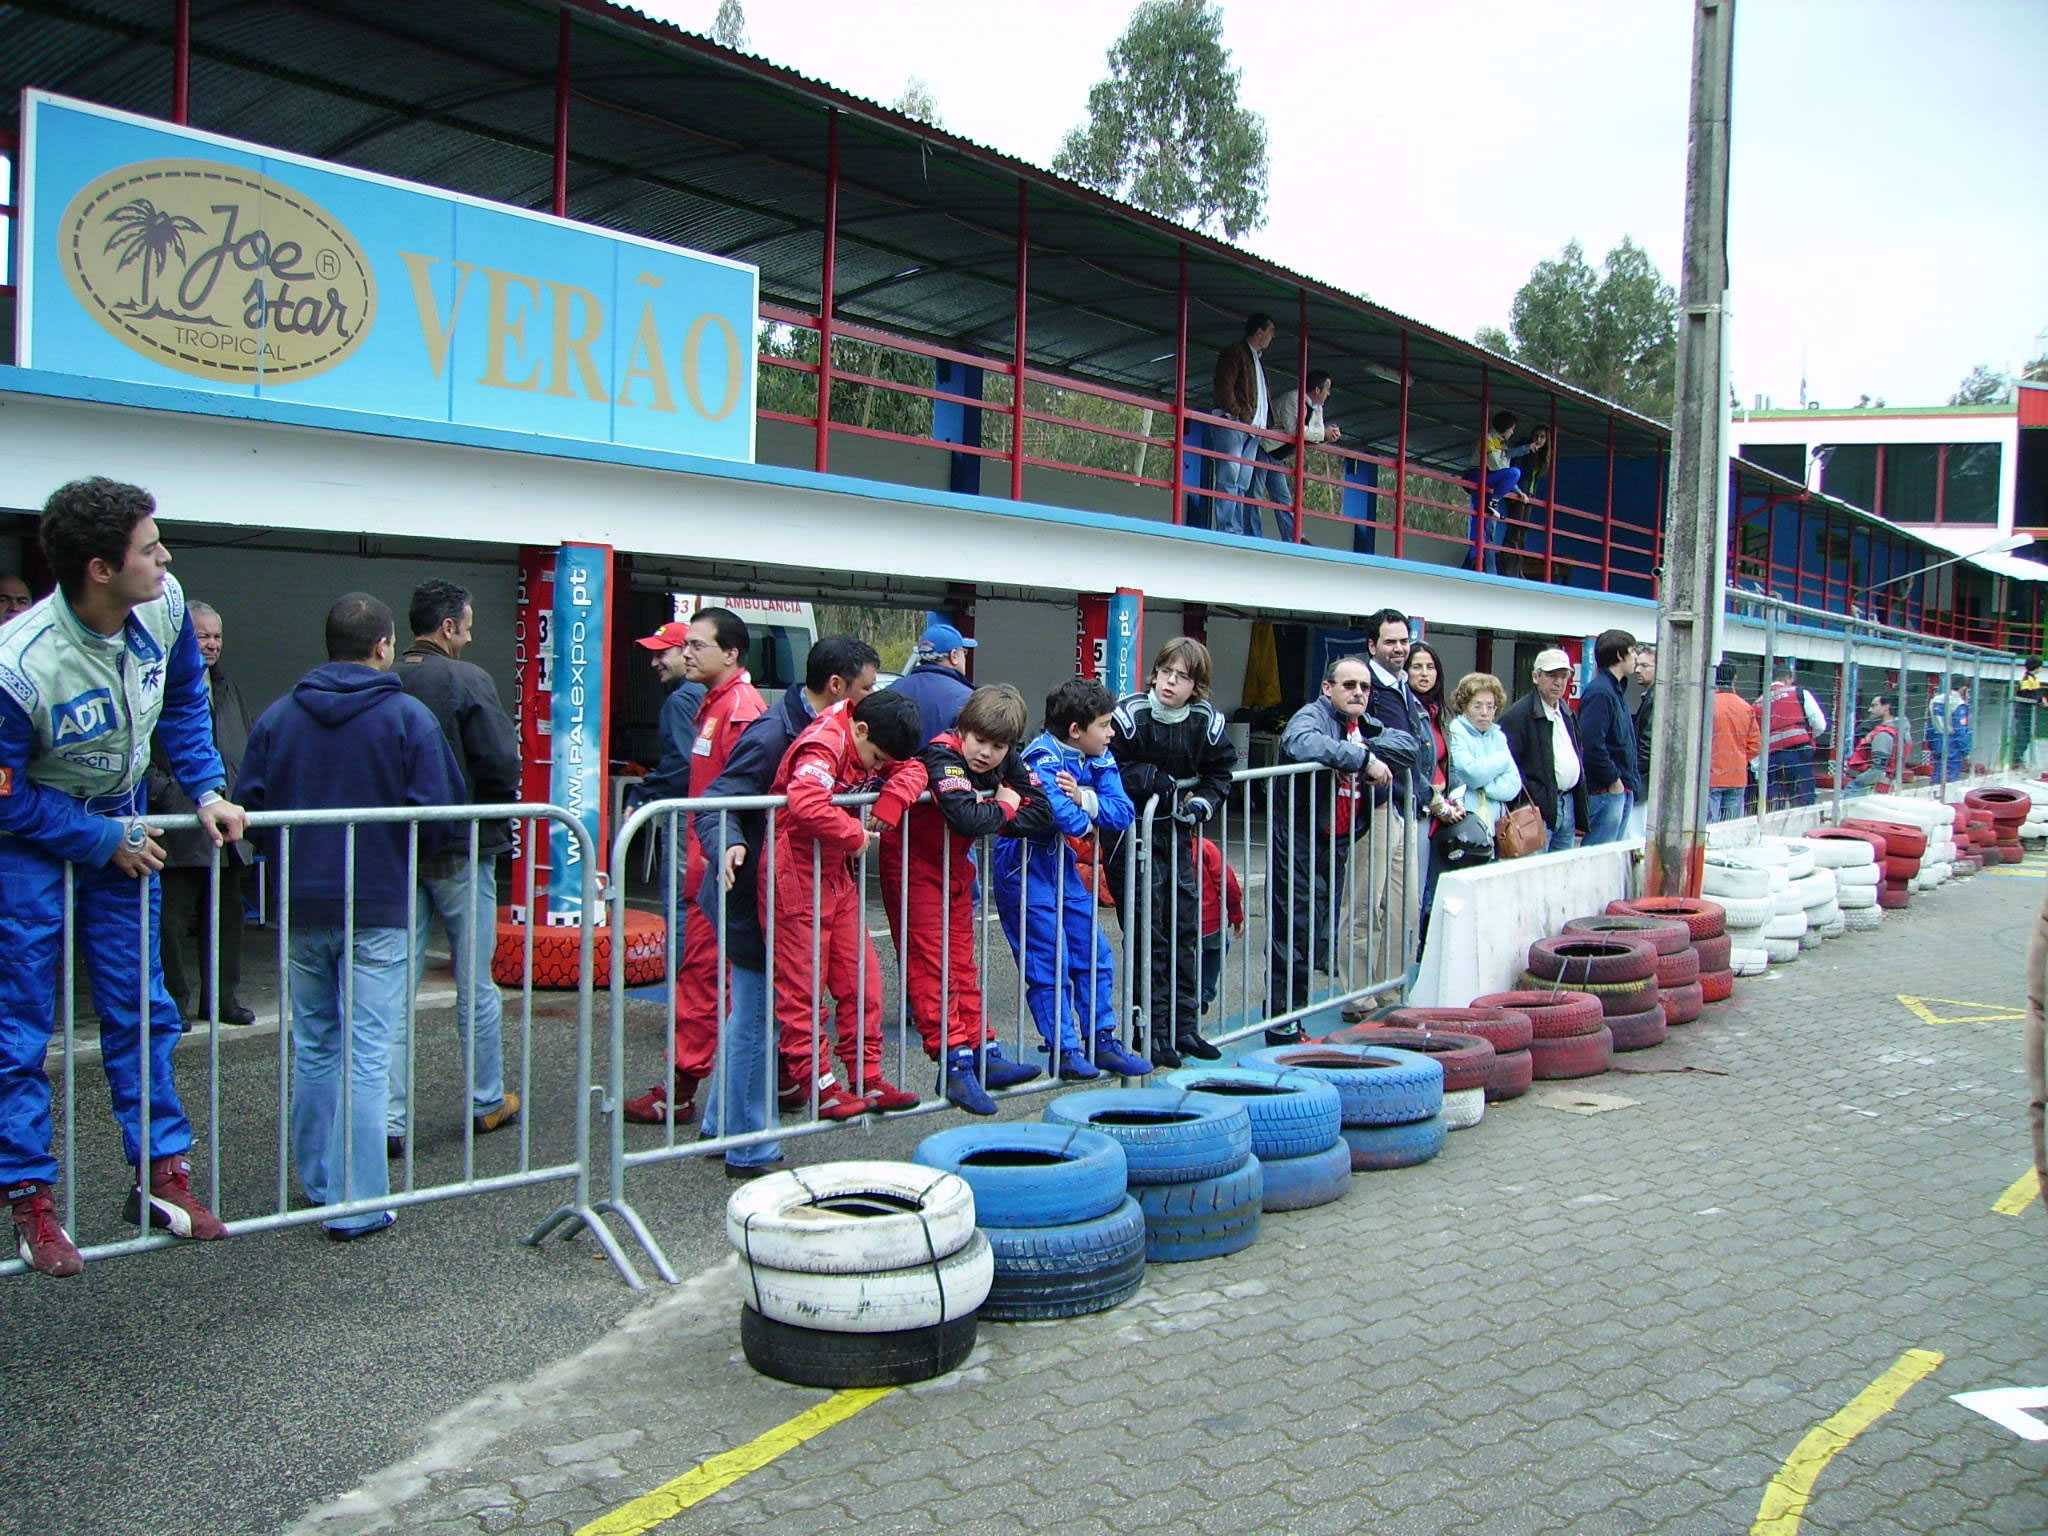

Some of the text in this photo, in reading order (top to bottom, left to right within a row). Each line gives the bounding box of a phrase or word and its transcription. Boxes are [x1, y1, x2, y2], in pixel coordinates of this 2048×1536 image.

[178, 204, 315, 311] Joe
[174, 326, 287, 362] TROPICAL
[399, 250, 743, 422] VERÃO
[56, 697, 110, 740] ADT
